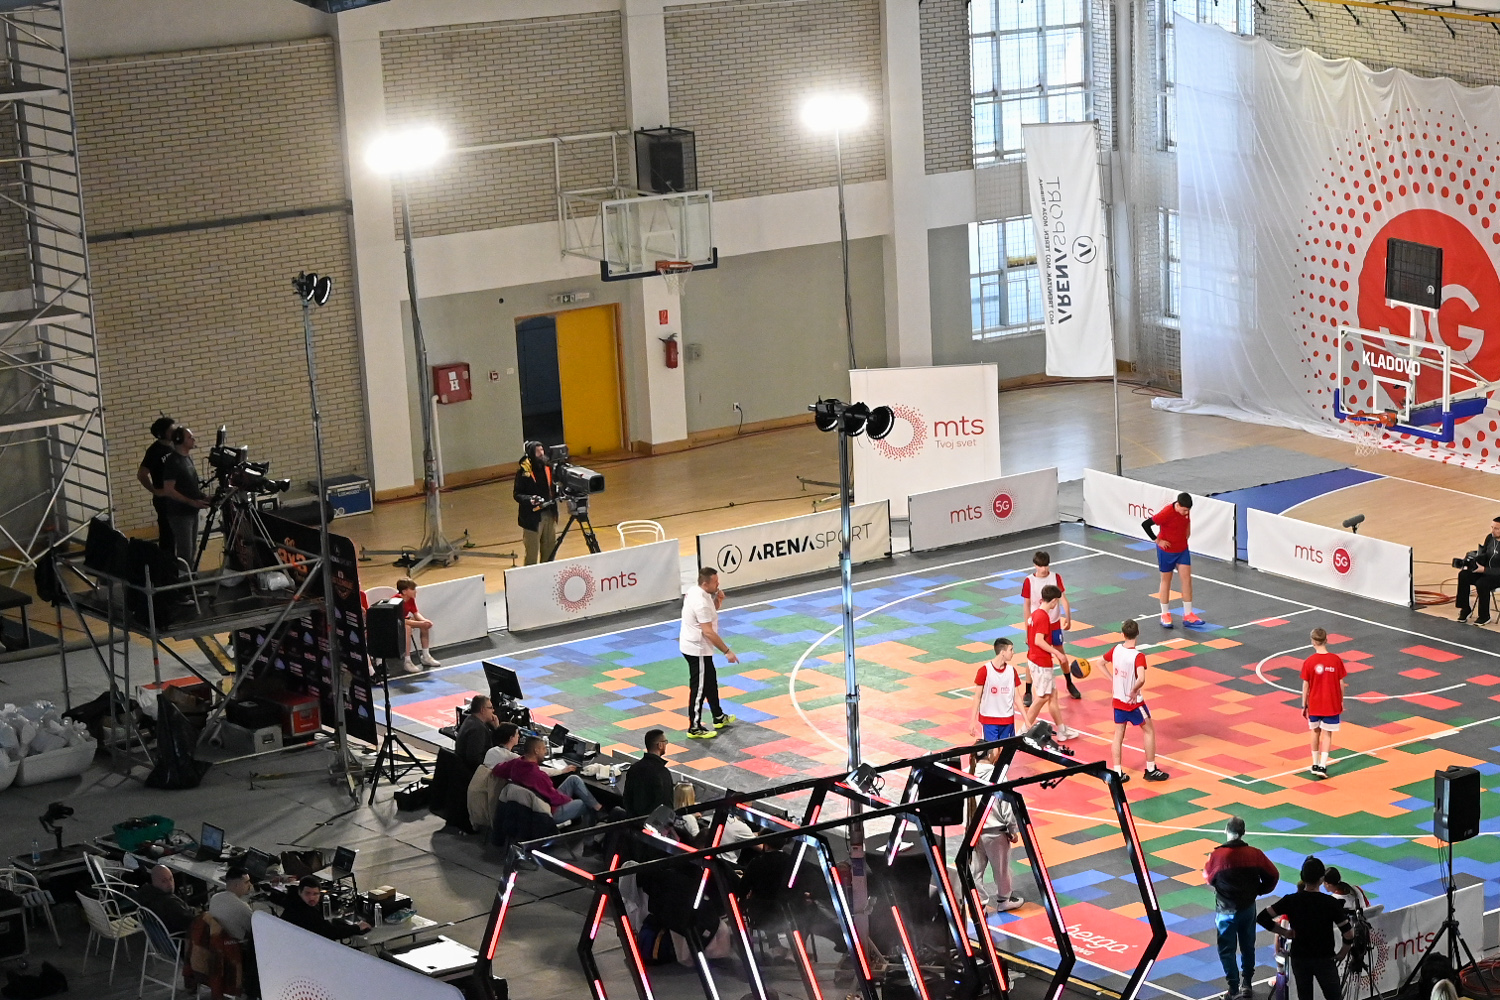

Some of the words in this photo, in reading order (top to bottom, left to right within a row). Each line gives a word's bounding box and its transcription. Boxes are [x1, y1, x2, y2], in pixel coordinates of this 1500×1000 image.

[1362, 350, 1421, 377] KLADOVO
[933, 415, 985, 437] mts
[935, 439, 955, 450] Tvoj
[956, 438, 977, 448] svet
[950, 503, 983, 524] mts
[994, 500, 1011, 513] 5G
[1128, 502, 1154, 519] mts
[1293, 543, 1324, 564] mts
[1333, 553, 1349, 567] 5G
[600, 571, 638, 592] mts
[1394, 930, 1437, 960] mts
